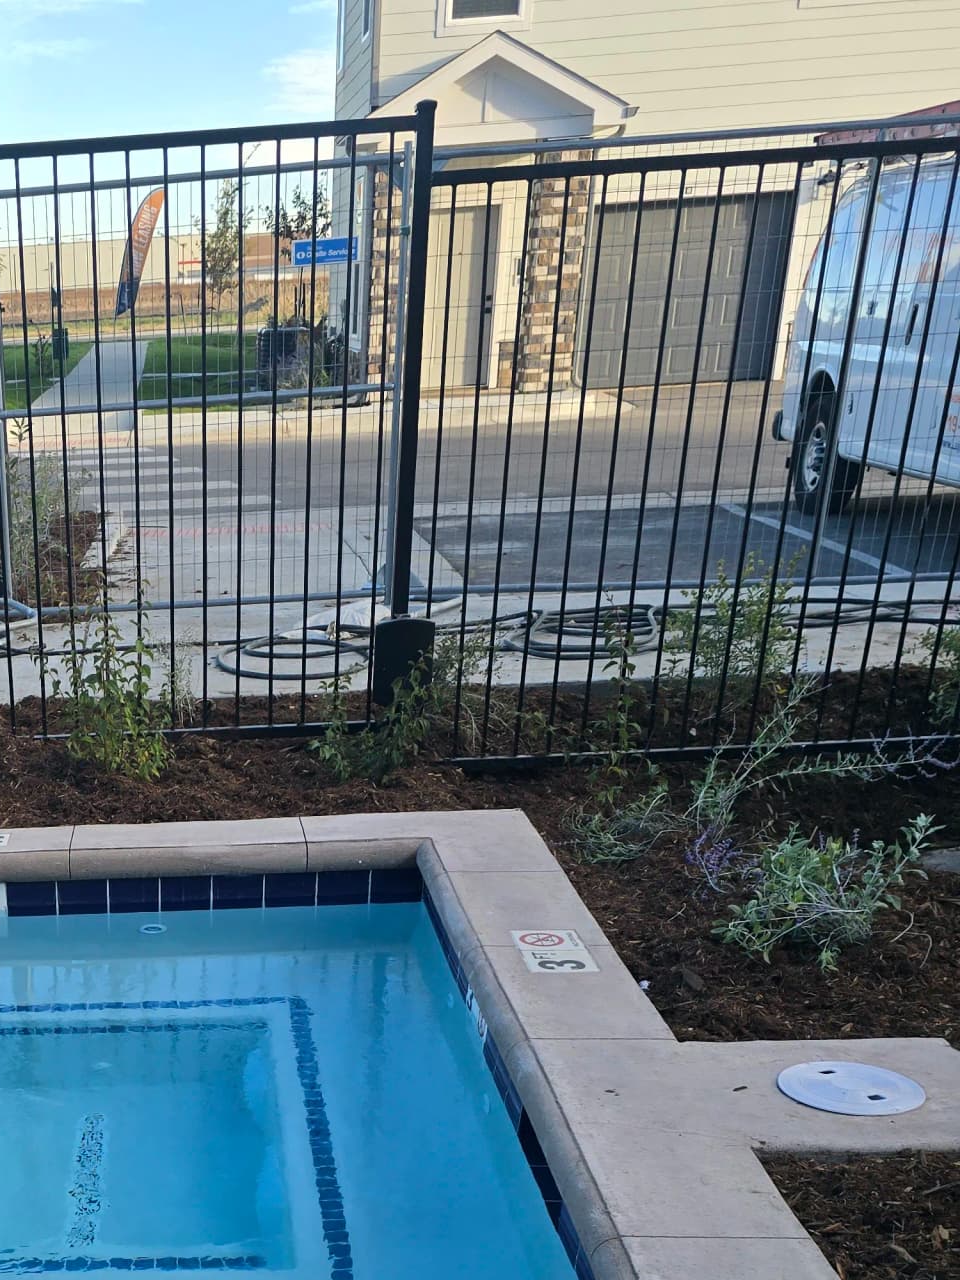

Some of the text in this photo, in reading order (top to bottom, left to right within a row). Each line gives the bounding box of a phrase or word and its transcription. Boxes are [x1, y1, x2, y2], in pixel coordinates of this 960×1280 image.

[134, 204, 158, 248] LEASING
[531, 951, 586, 971] 3 FT
